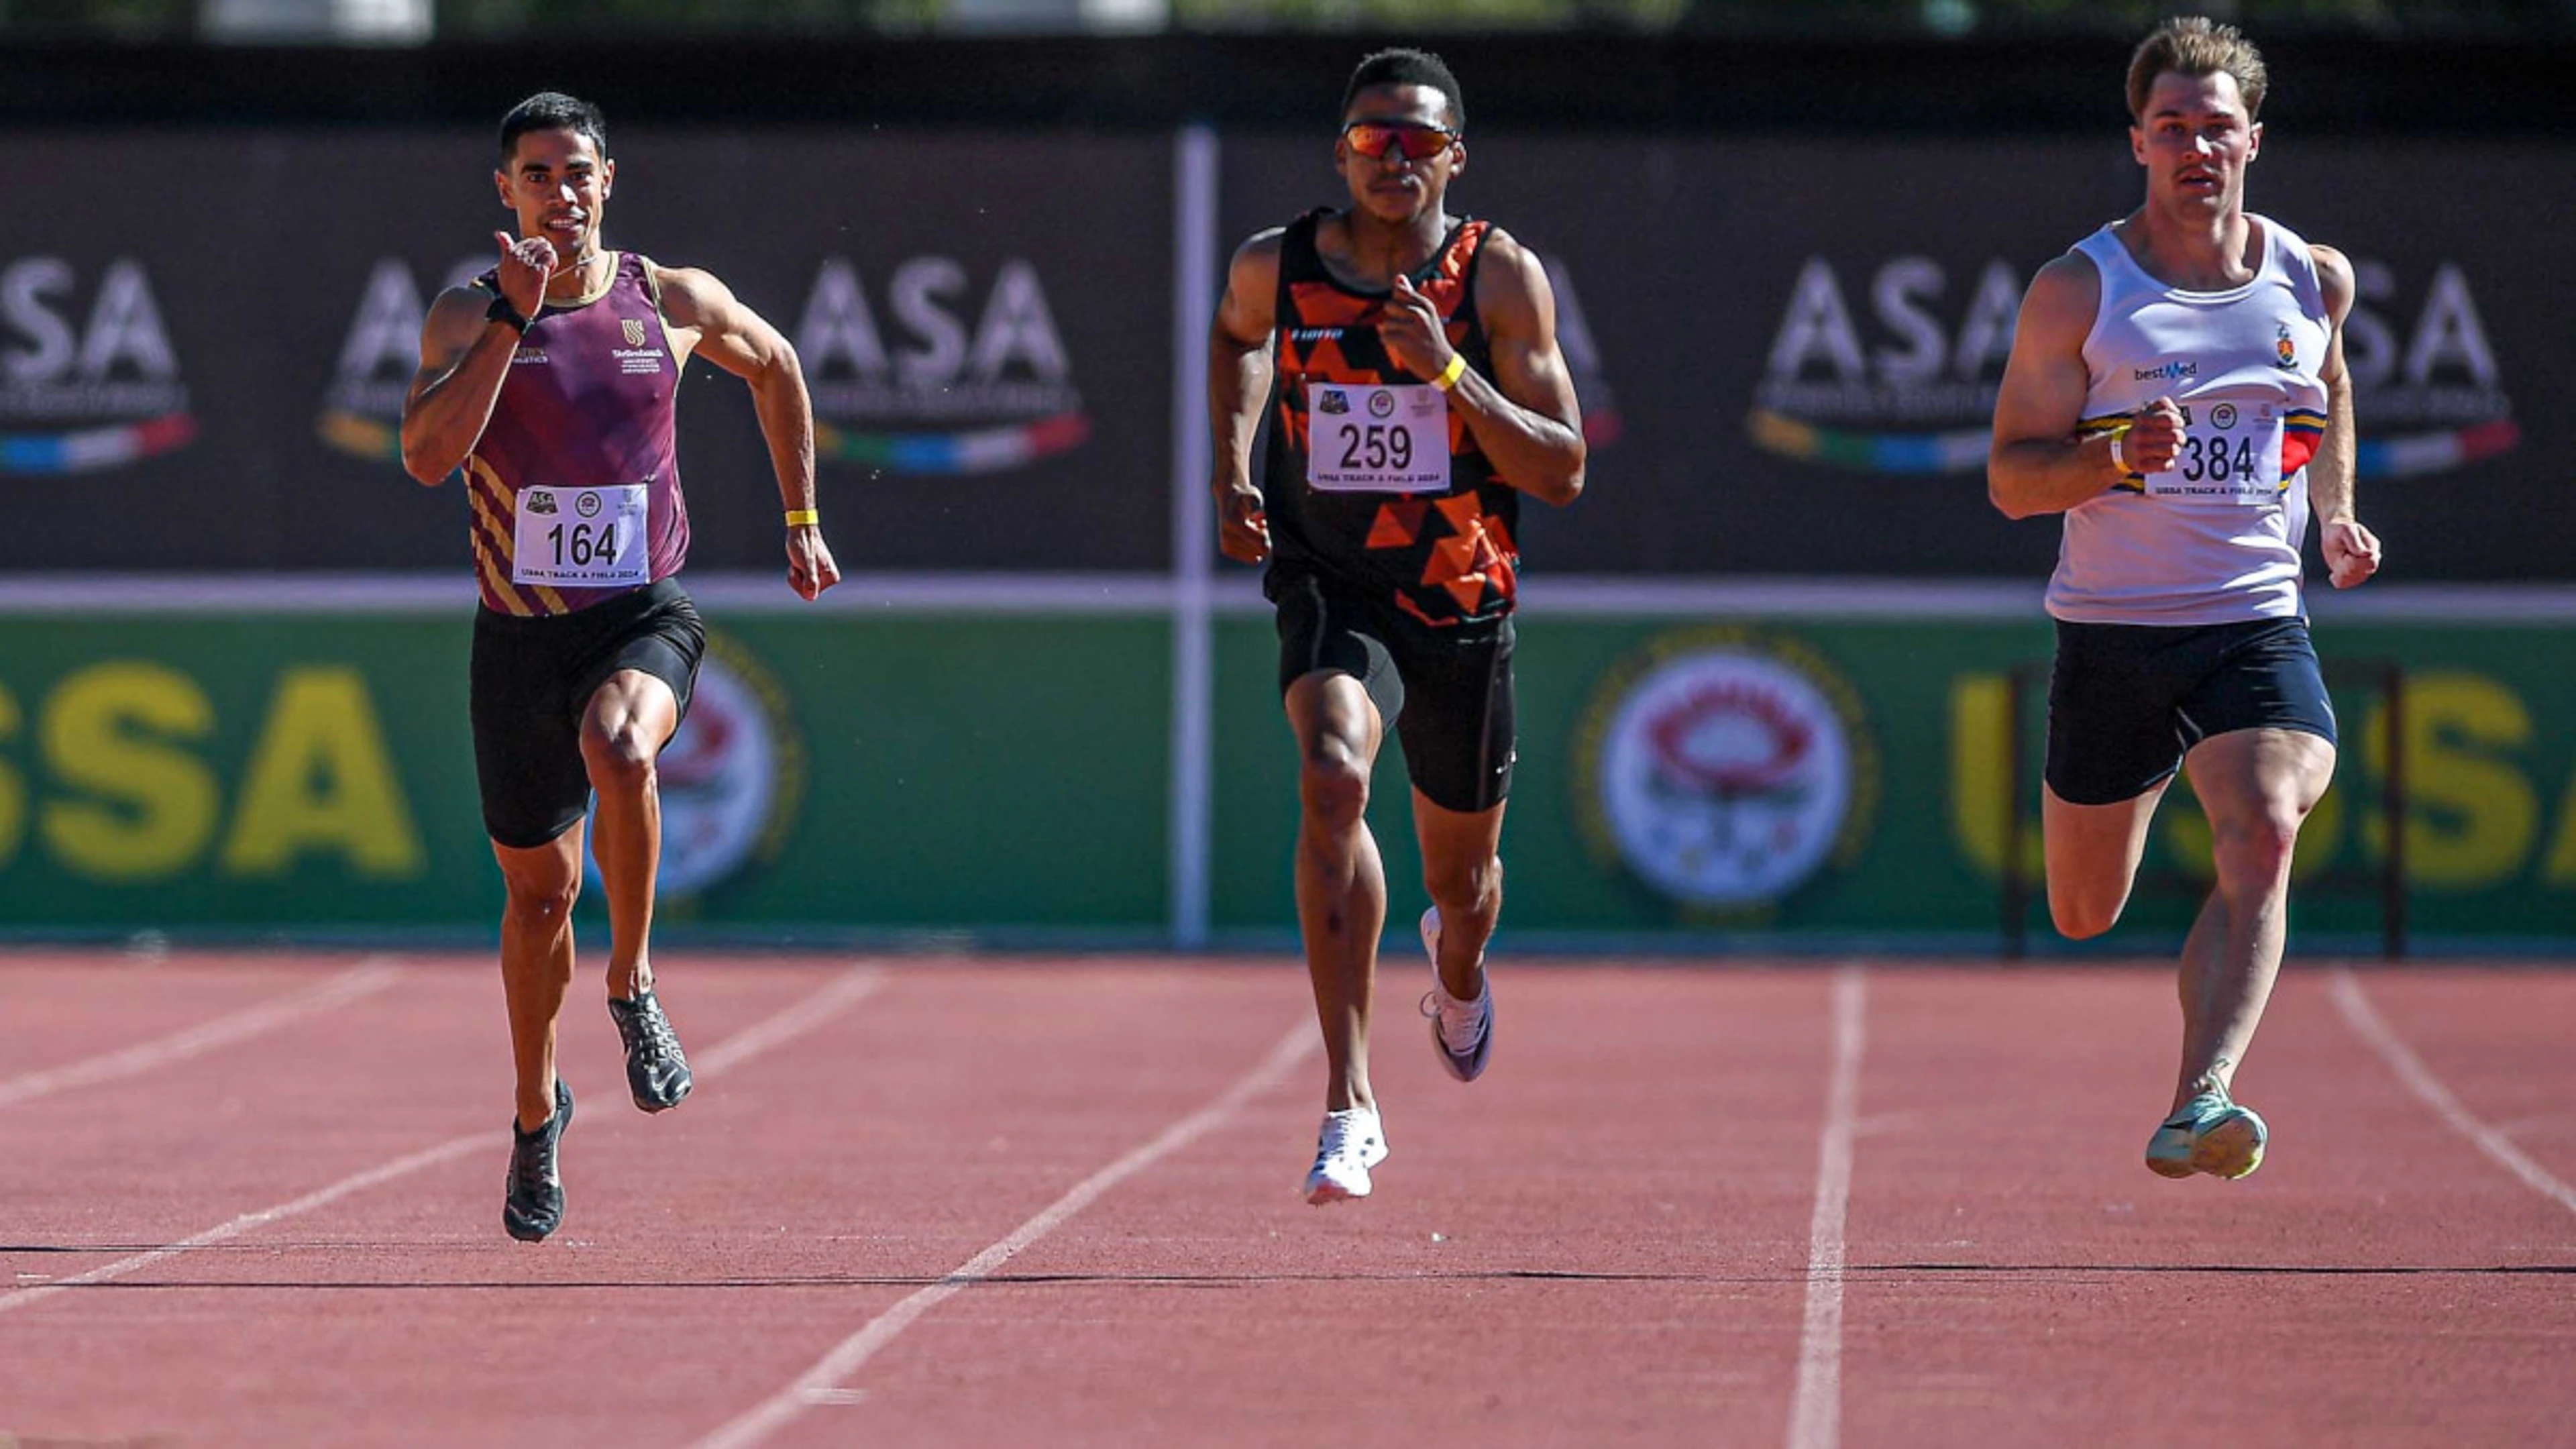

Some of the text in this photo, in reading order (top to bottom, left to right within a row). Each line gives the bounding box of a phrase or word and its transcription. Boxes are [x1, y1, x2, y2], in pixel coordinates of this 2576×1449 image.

[797, 256, 1070, 381] ASA
[1339, 424, 1413, 470] 259
[2183, 436, 2255, 482] 384
[548, 523, 616, 566] 164
[0, 661, 424, 883] SA
